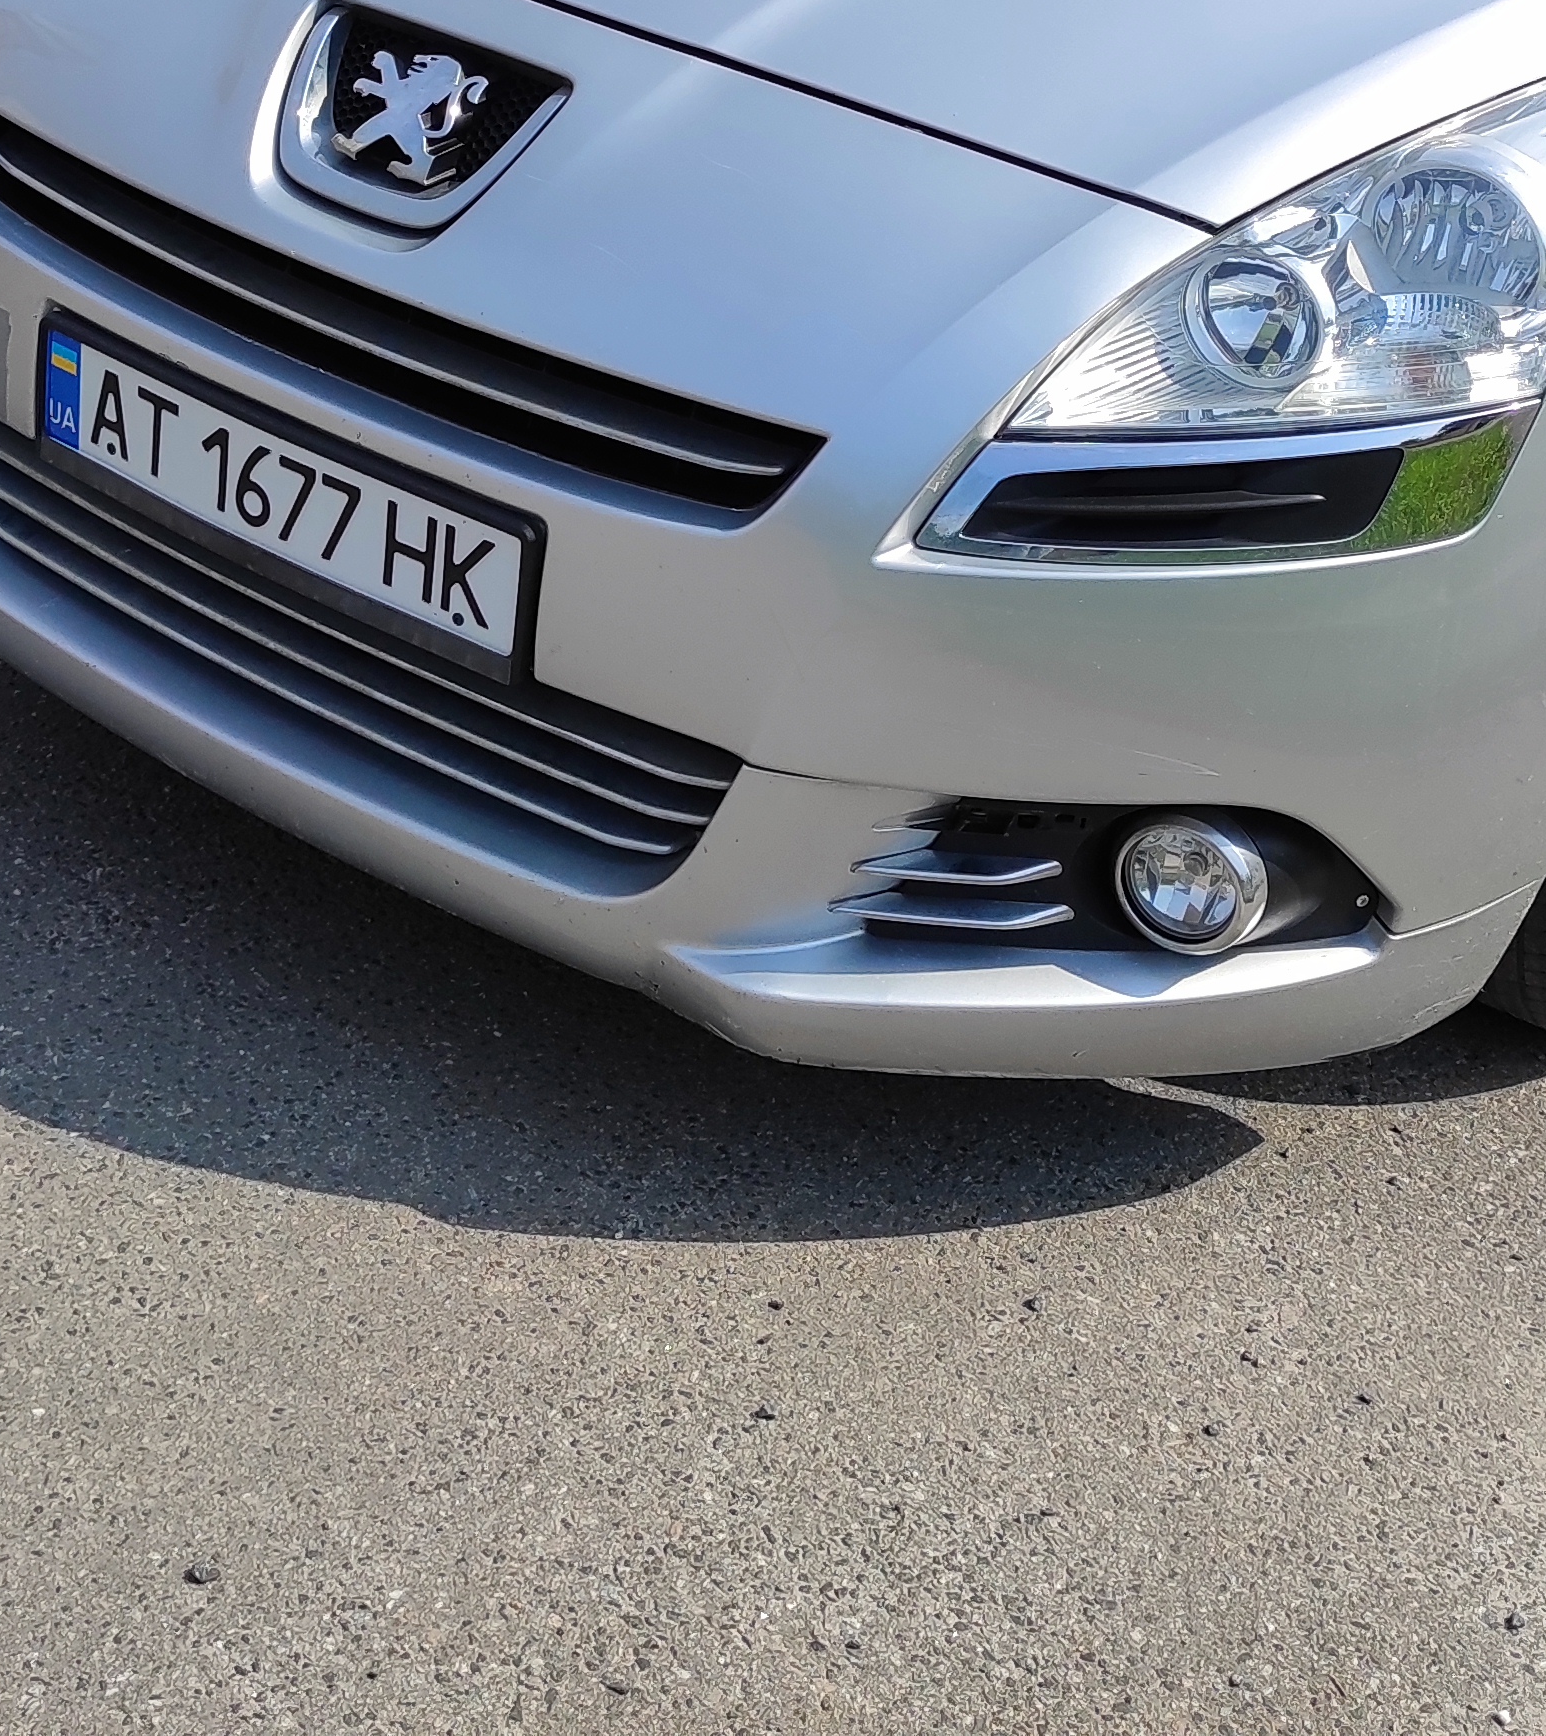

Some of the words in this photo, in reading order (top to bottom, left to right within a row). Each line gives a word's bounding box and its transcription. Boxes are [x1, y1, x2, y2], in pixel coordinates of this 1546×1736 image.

[49, 397, 77, 434] UA
[90, 369, 180, 478] AT
[201, 426, 362, 561] 1677
[382, 499, 496, 630] HK
